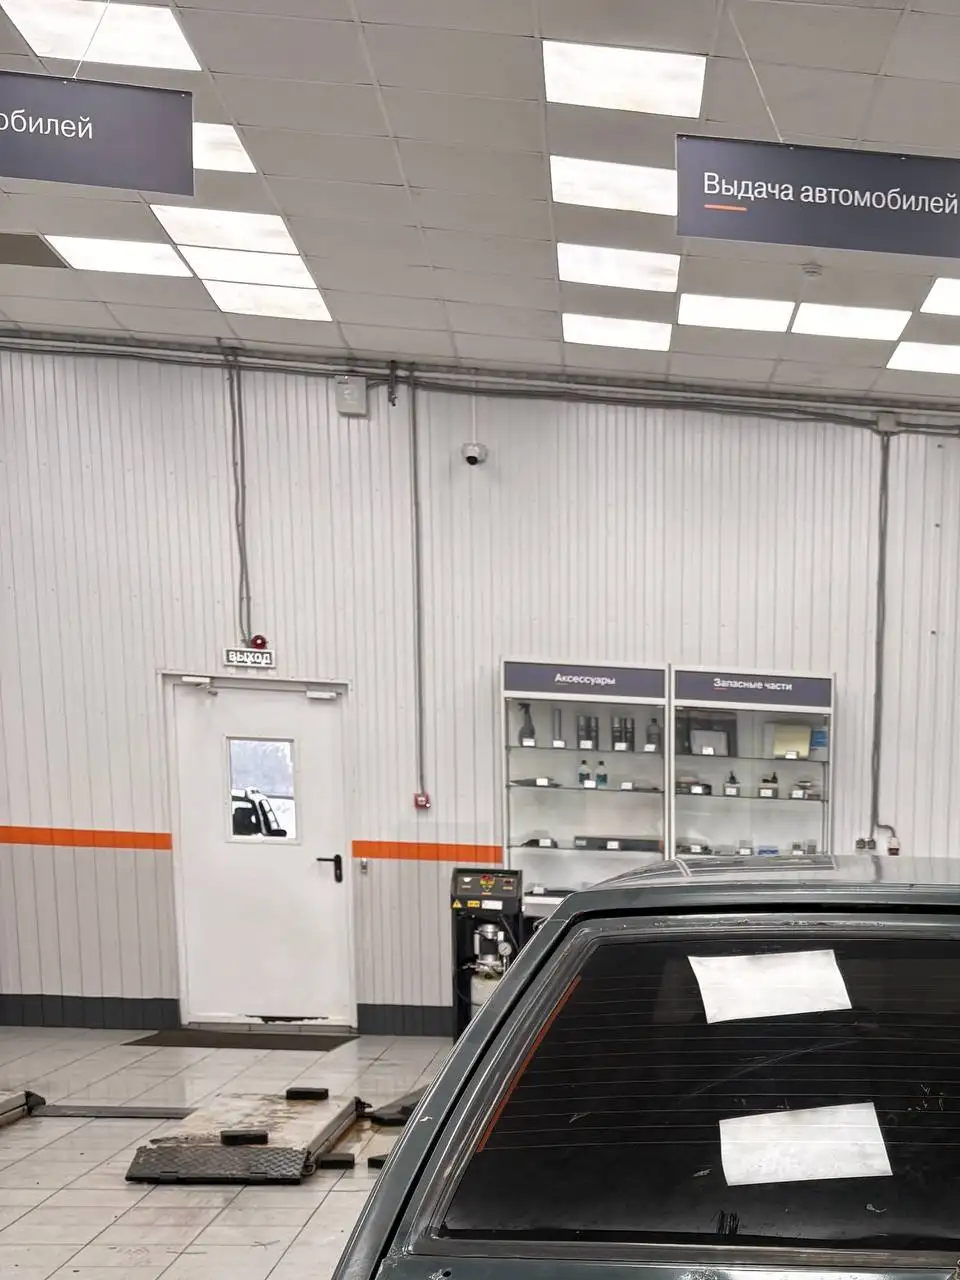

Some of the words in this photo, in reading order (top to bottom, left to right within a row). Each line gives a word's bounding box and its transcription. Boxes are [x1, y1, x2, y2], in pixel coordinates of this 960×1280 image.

[703, 171, 794, 202] Выдача
[800, 184, 959, 215] автомобилей
[229, 651, 271, 664] ВЫХОД
[554, 672, 616, 686] Аксессуары
[713, 677, 763, 690] Запасные
[764, 682, 793, 692] части
